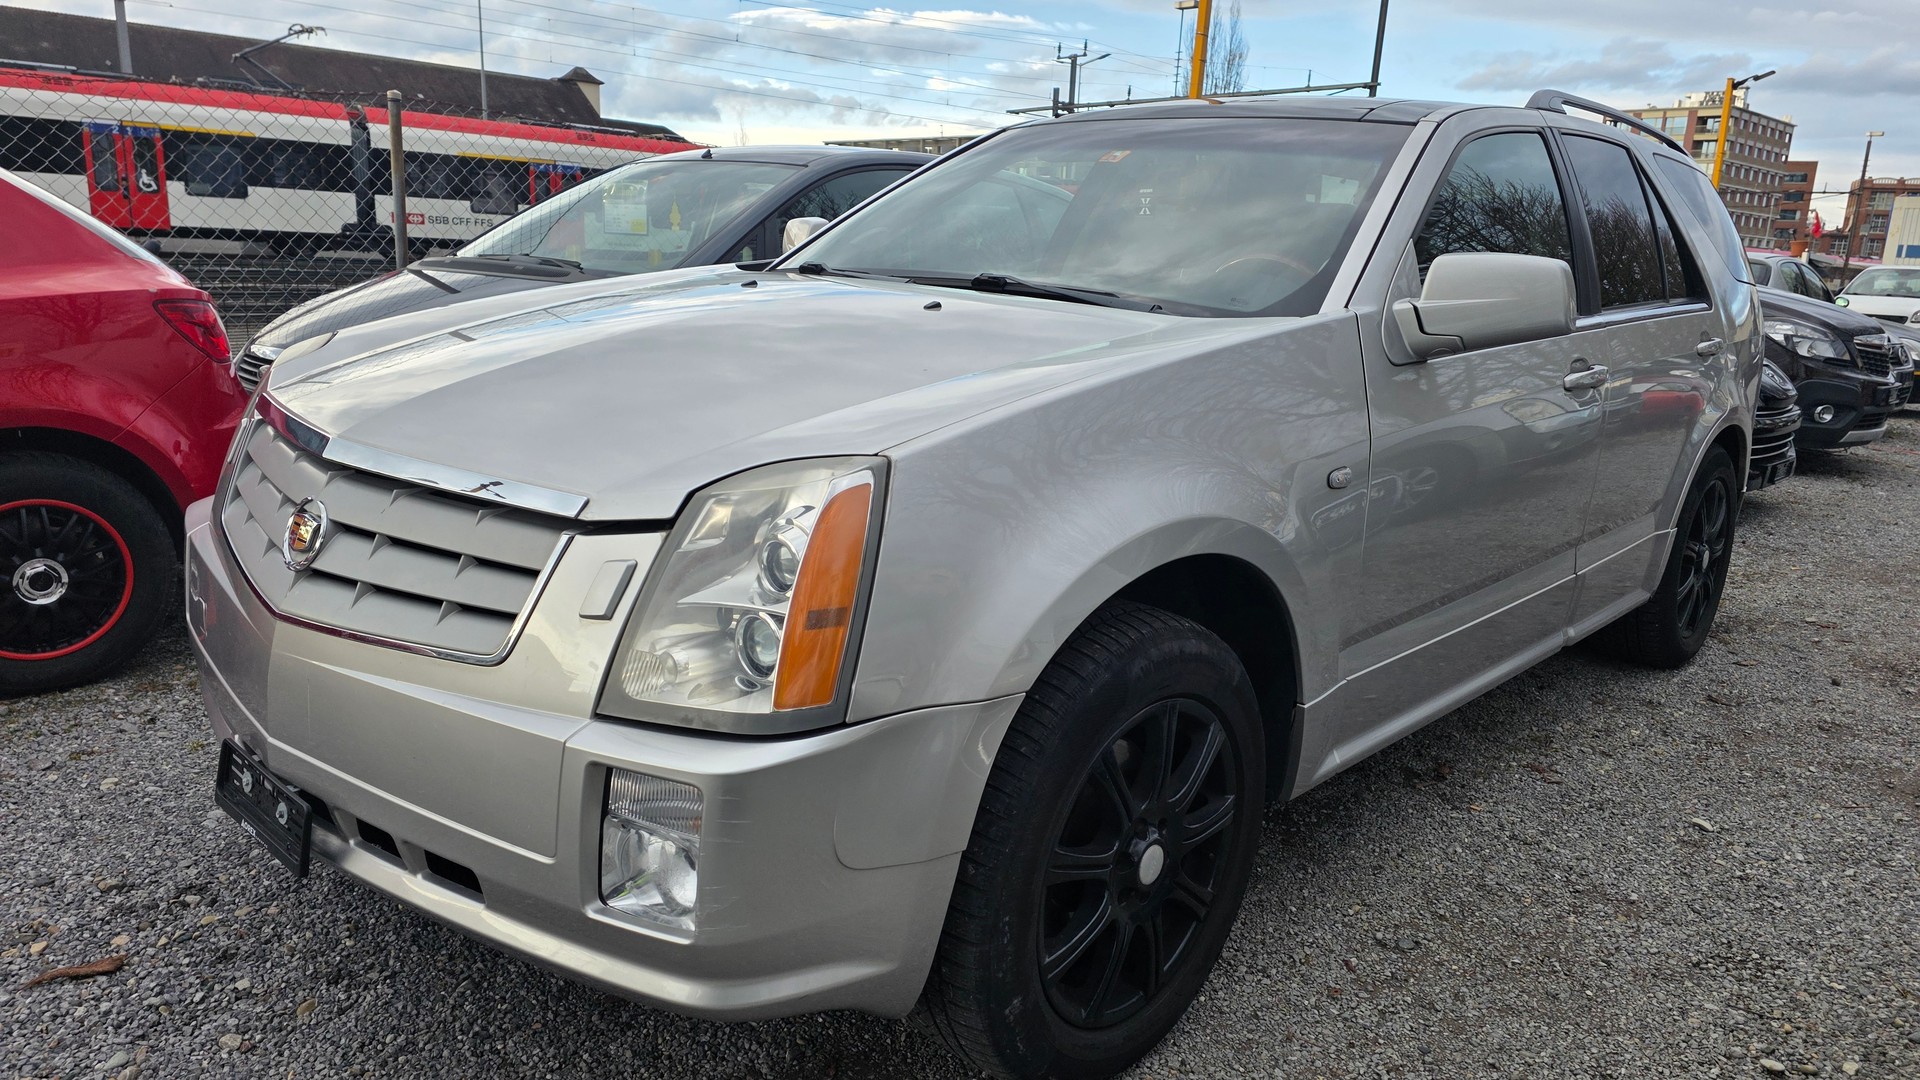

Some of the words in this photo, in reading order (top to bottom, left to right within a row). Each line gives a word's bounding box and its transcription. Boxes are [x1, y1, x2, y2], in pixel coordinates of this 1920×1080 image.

[112, 126, 120, 134] 2
[427, 215, 450, 225] SBB
[452, 217, 472, 226] CFF
[474, 218, 494, 227] FFS
